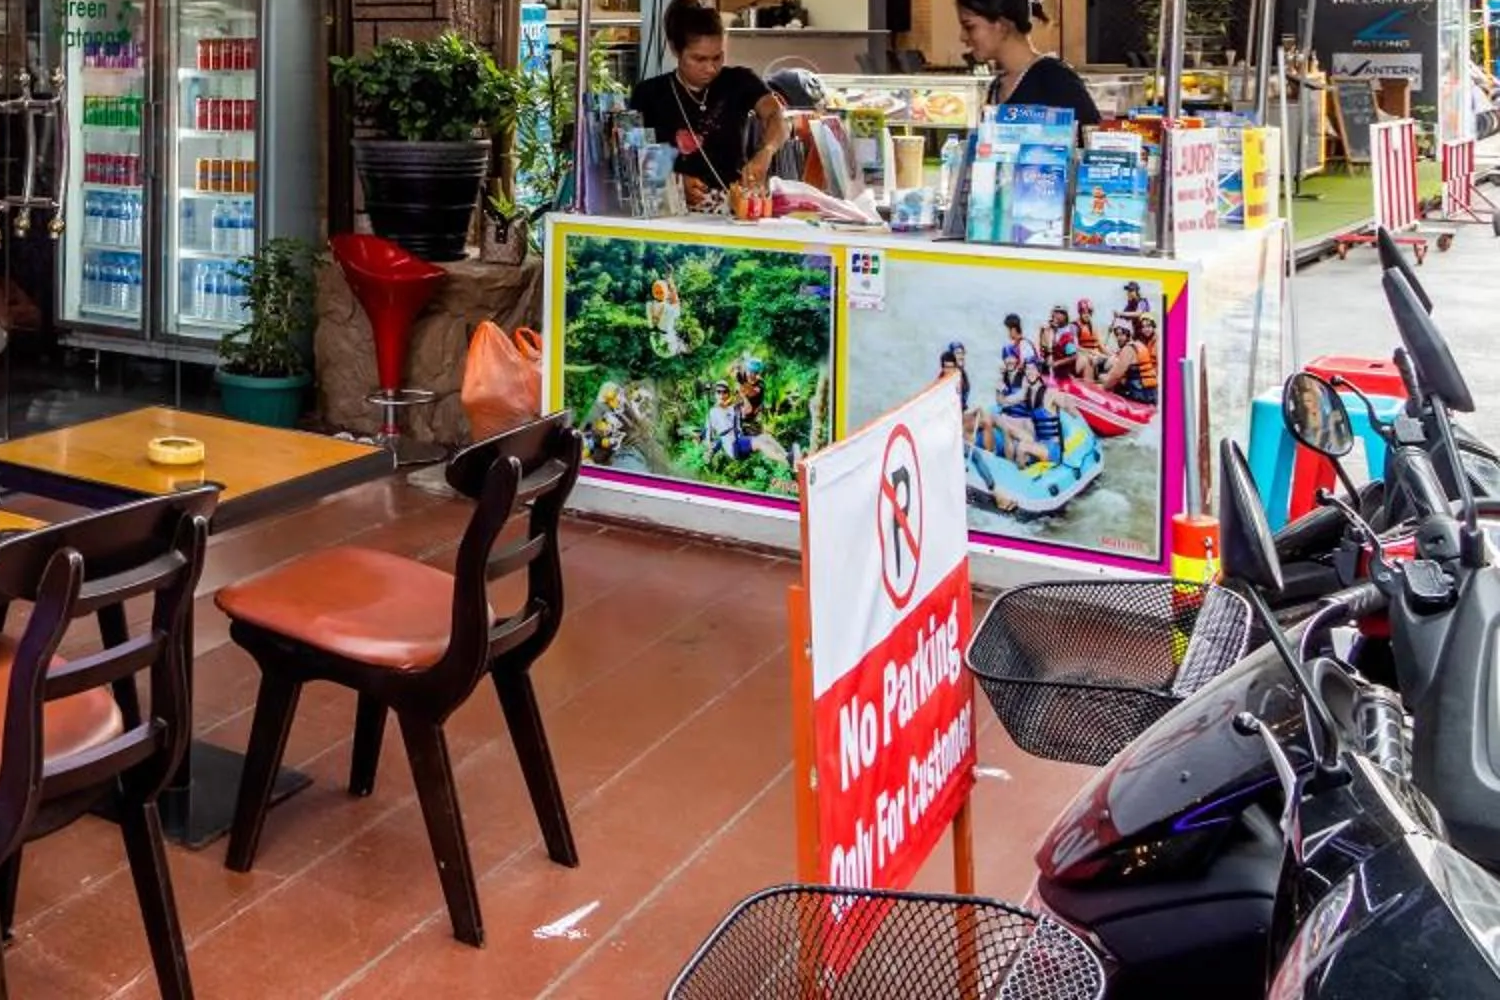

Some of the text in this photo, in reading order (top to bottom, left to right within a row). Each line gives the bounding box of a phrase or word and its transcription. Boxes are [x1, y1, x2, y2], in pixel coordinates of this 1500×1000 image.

[838, 598, 961, 793] No Parking
[876, 786, 905, 869] For
[907, 700, 972, 826] Customer
